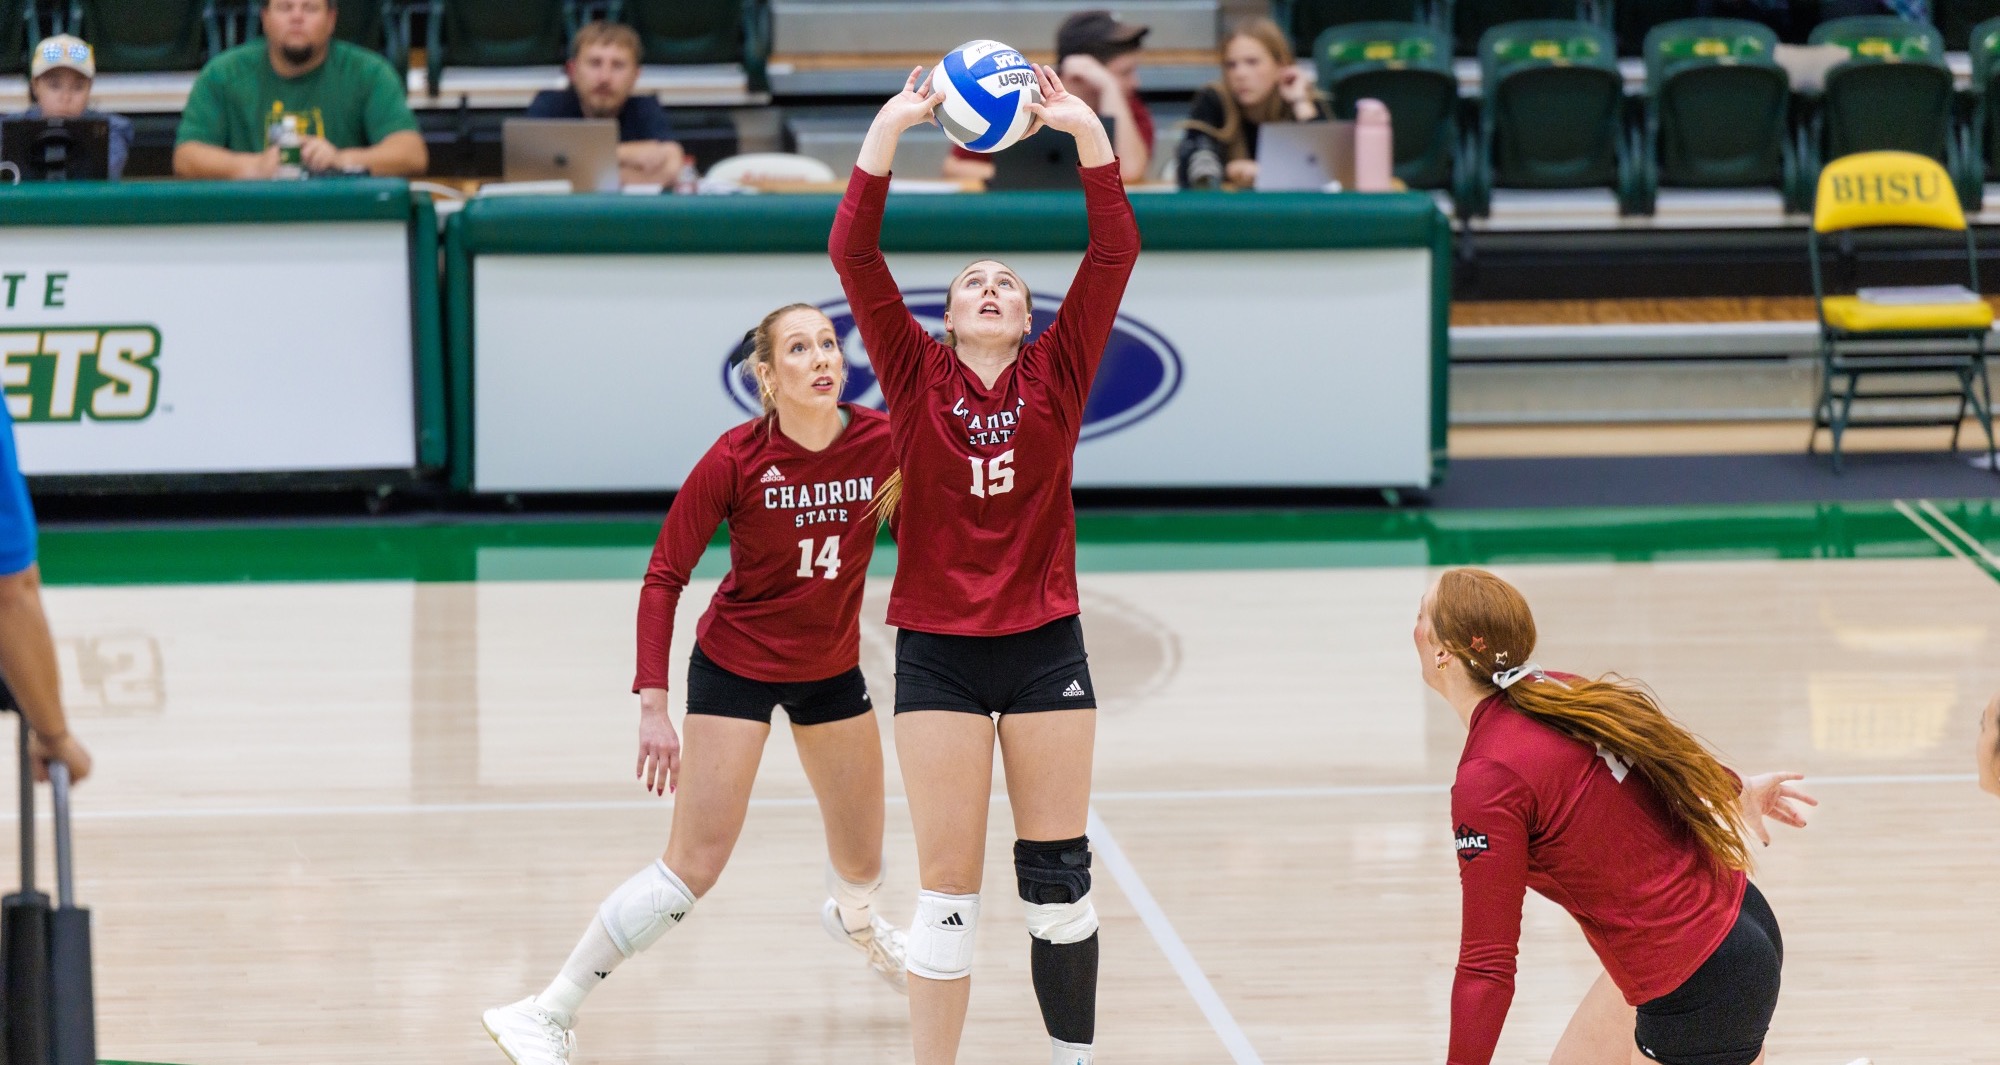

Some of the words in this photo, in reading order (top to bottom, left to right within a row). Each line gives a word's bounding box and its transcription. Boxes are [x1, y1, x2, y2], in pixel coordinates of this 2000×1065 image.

[1832, 169, 1940, 204] BHSU
[969, 430, 1015, 445] STAT
[760, 475, 785, 483] adidas
[968, 449, 1015, 499] 15
[764, 477, 873, 509] CHADRON
[795, 508, 848, 528] STATE
[796, 535, 841, 580] 14
